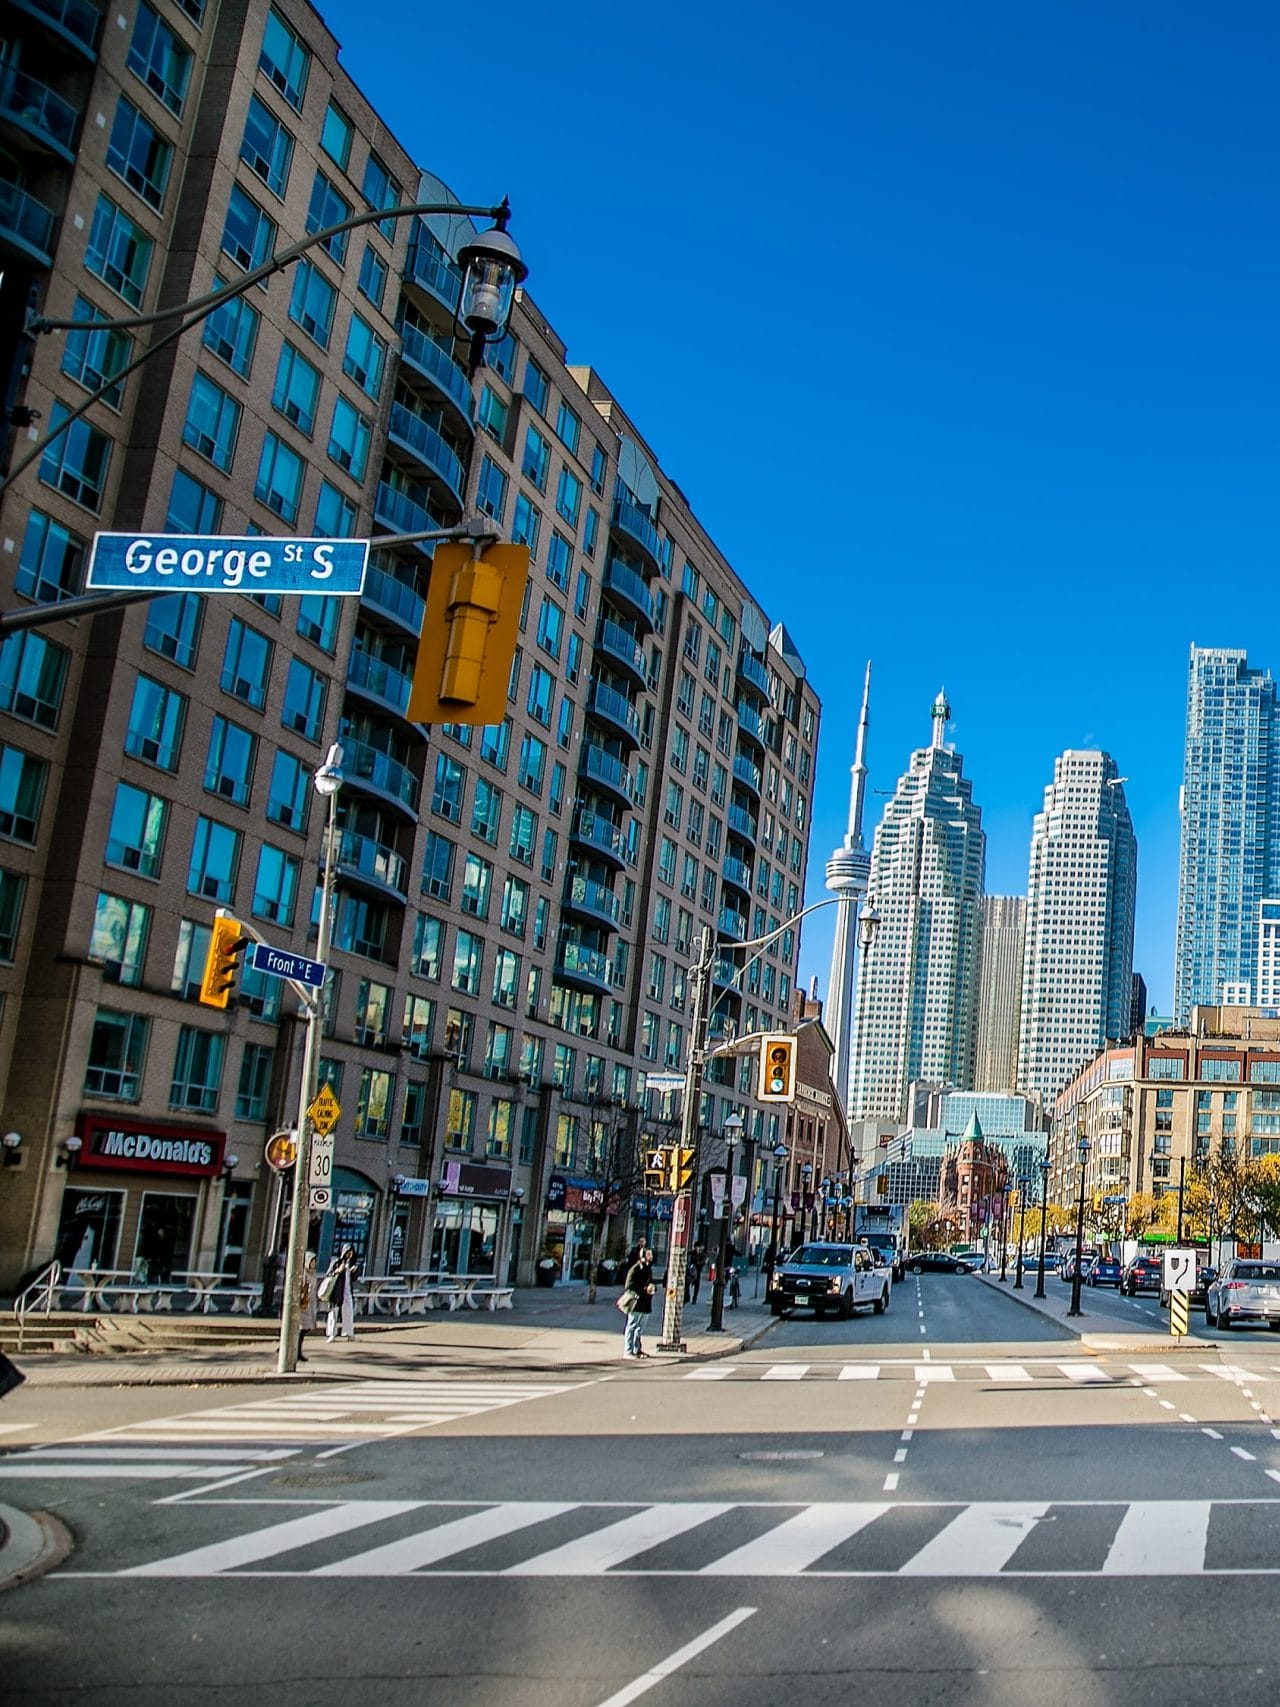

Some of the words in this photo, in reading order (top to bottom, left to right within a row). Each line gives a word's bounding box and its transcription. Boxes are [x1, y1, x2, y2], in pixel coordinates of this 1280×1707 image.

[125, 540, 272, 587] George
[283, 544, 304, 562] St
[310, 544, 335, 580] S
[267, 952, 295, 975] Front
[304, 963, 313, 980] E
[104, 1131, 212, 1166] McDonald's
[314, 1155, 331, 1177] 30
